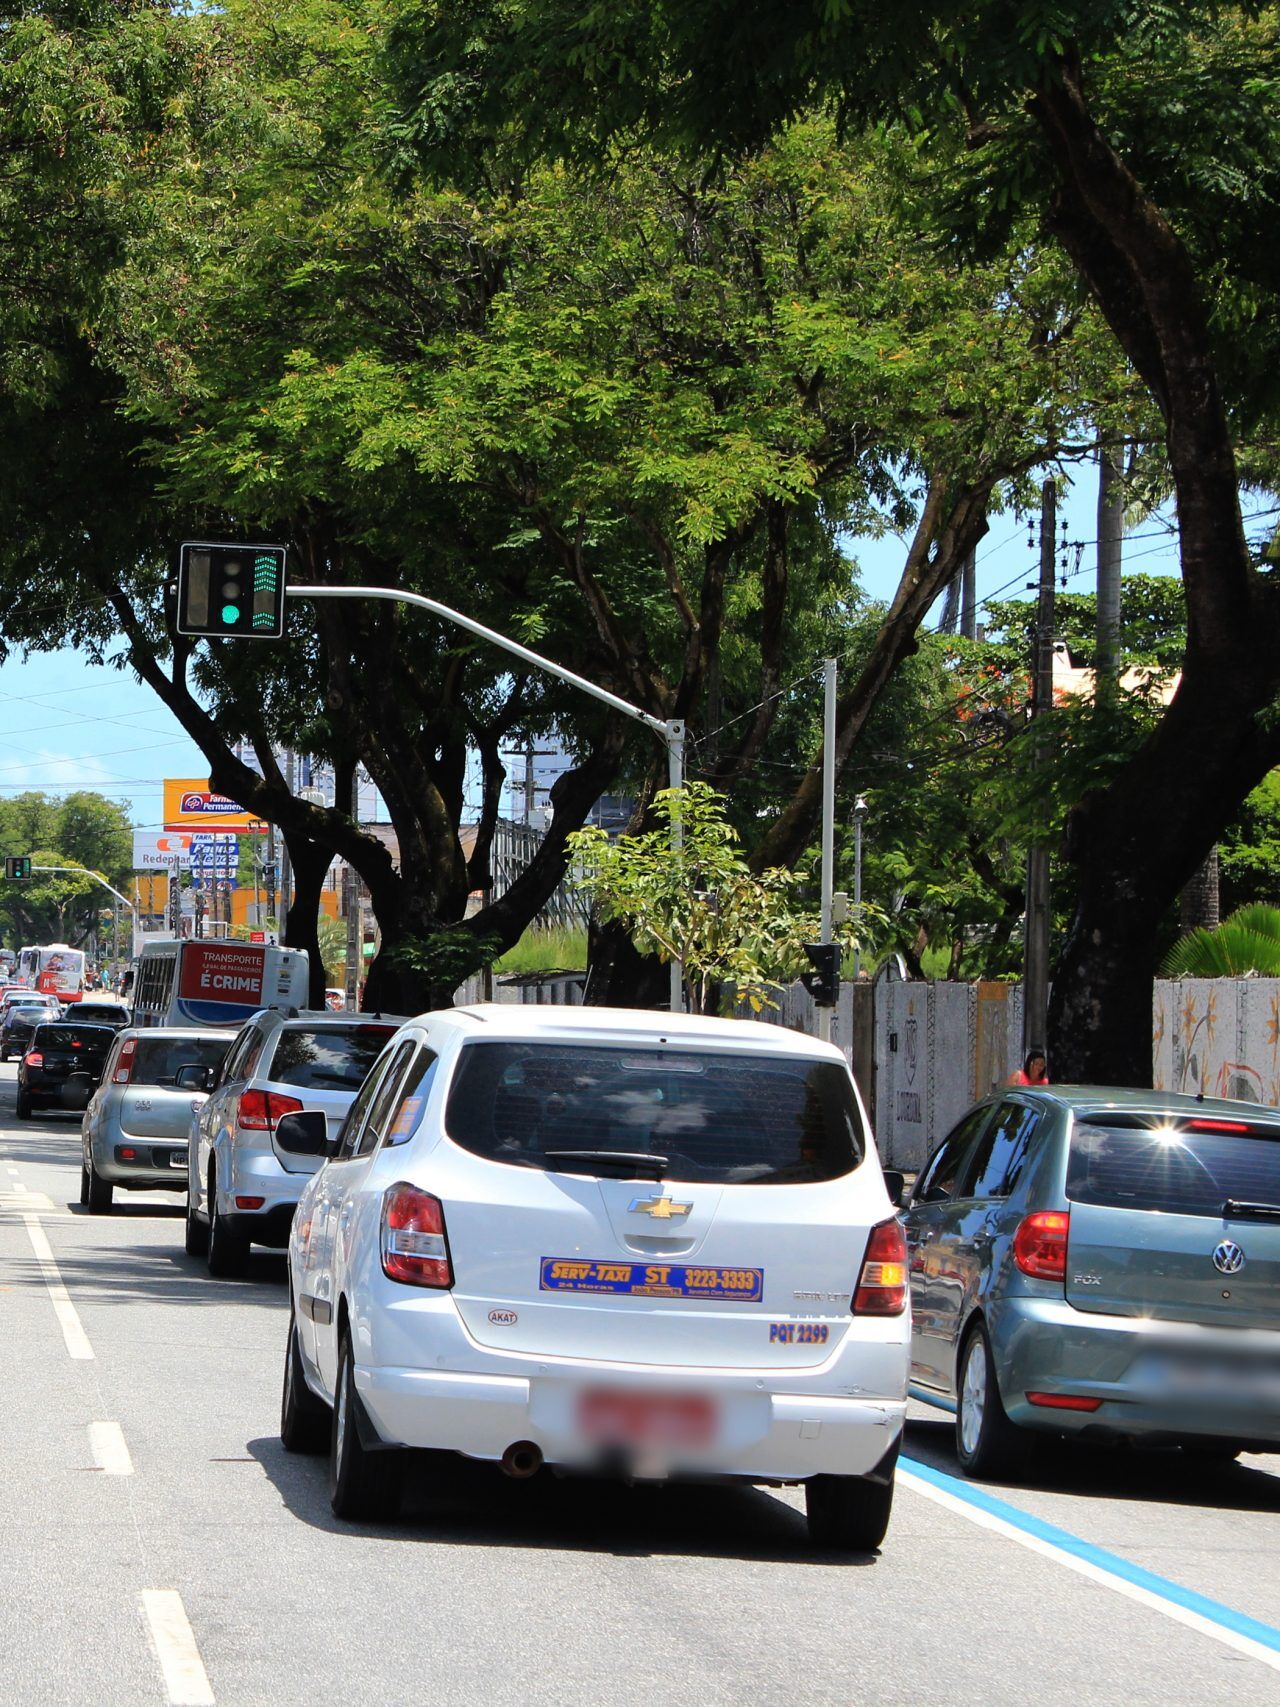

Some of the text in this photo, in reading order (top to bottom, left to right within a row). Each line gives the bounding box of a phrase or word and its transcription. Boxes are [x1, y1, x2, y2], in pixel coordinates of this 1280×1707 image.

[210, 794, 235, 803] Farm
[203, 951, 263, 966] TRANSPORTE
[200, 969, 211, 988] É
[213, 975, 261, 993] CRIME
[645, 1266, 671, 1284] ST
[684, 1268, 755, 1290] 3223-3333
[1073, 1275, 1102, 1286] FOX
[491, 1312, 515, 1323] AKAT
[797, 1323, 829, 1344] 2299
